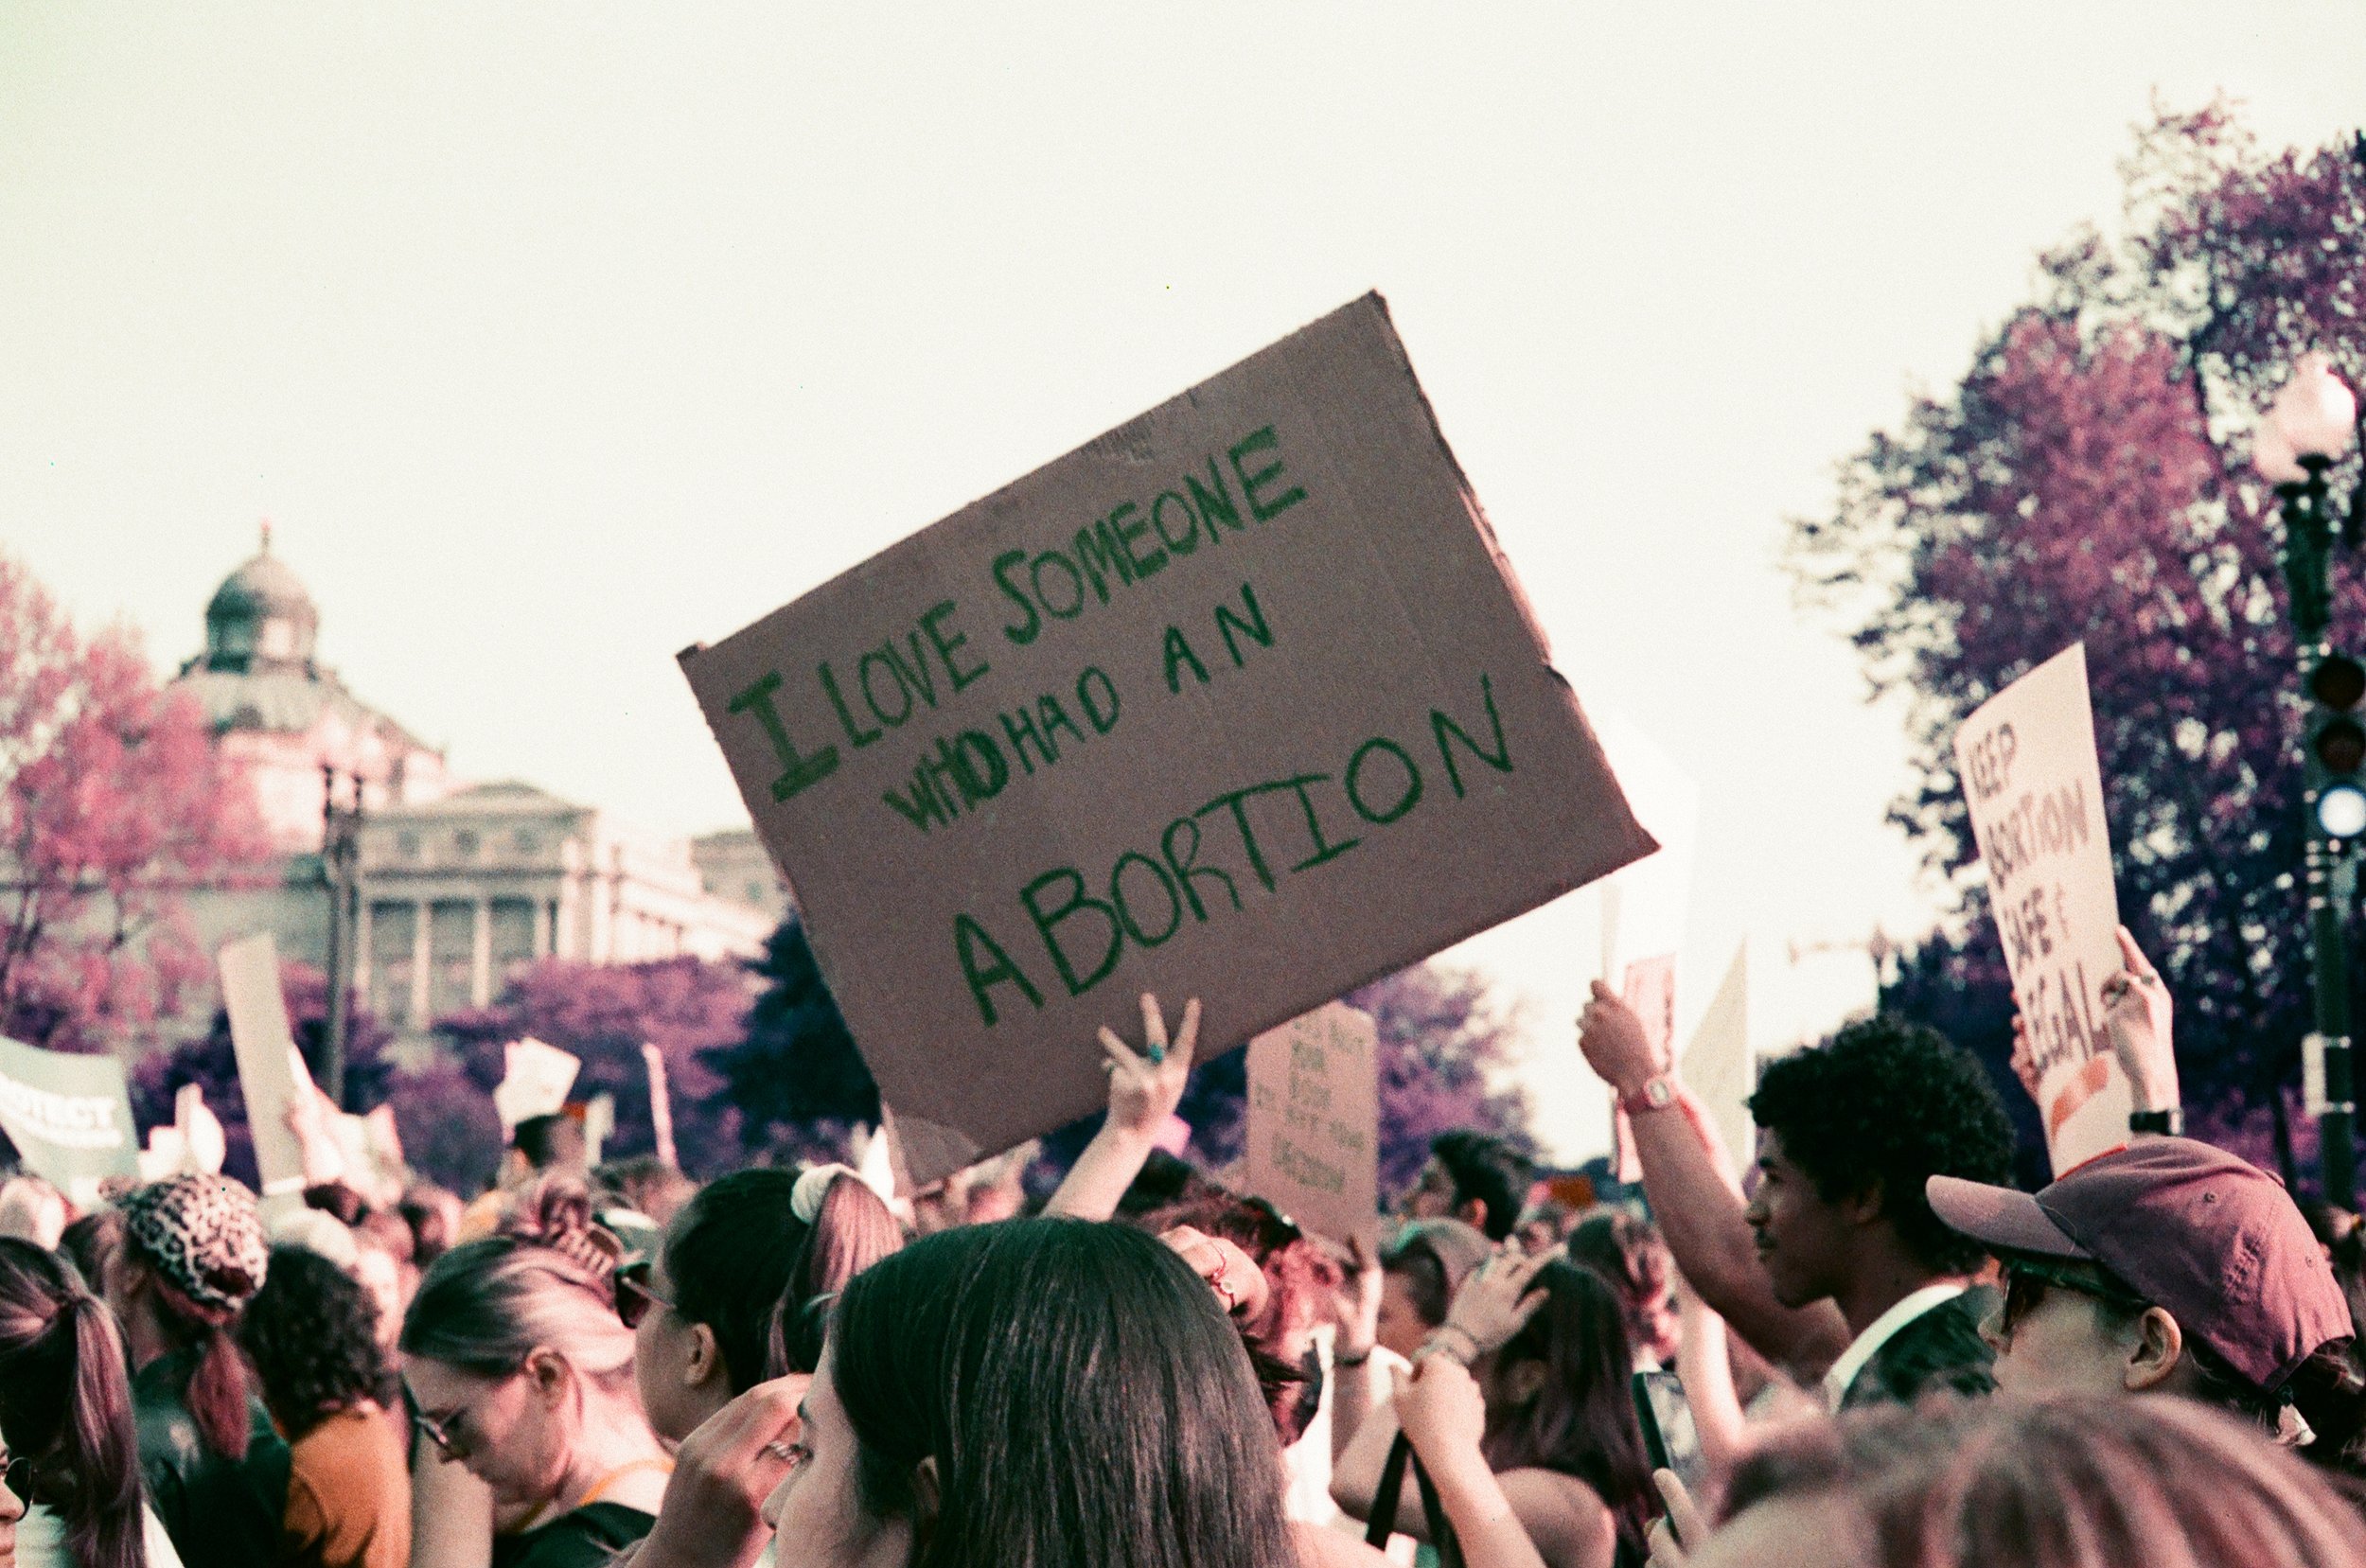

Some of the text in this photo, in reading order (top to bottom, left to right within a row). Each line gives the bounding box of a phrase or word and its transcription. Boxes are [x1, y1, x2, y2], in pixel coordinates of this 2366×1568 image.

[727, 423, 1308, 804] I LOVE SOMEONE
[881, 581, 1275, 832] WHO HAD AN
[954, 673, 1513, 1027] ABORTION
